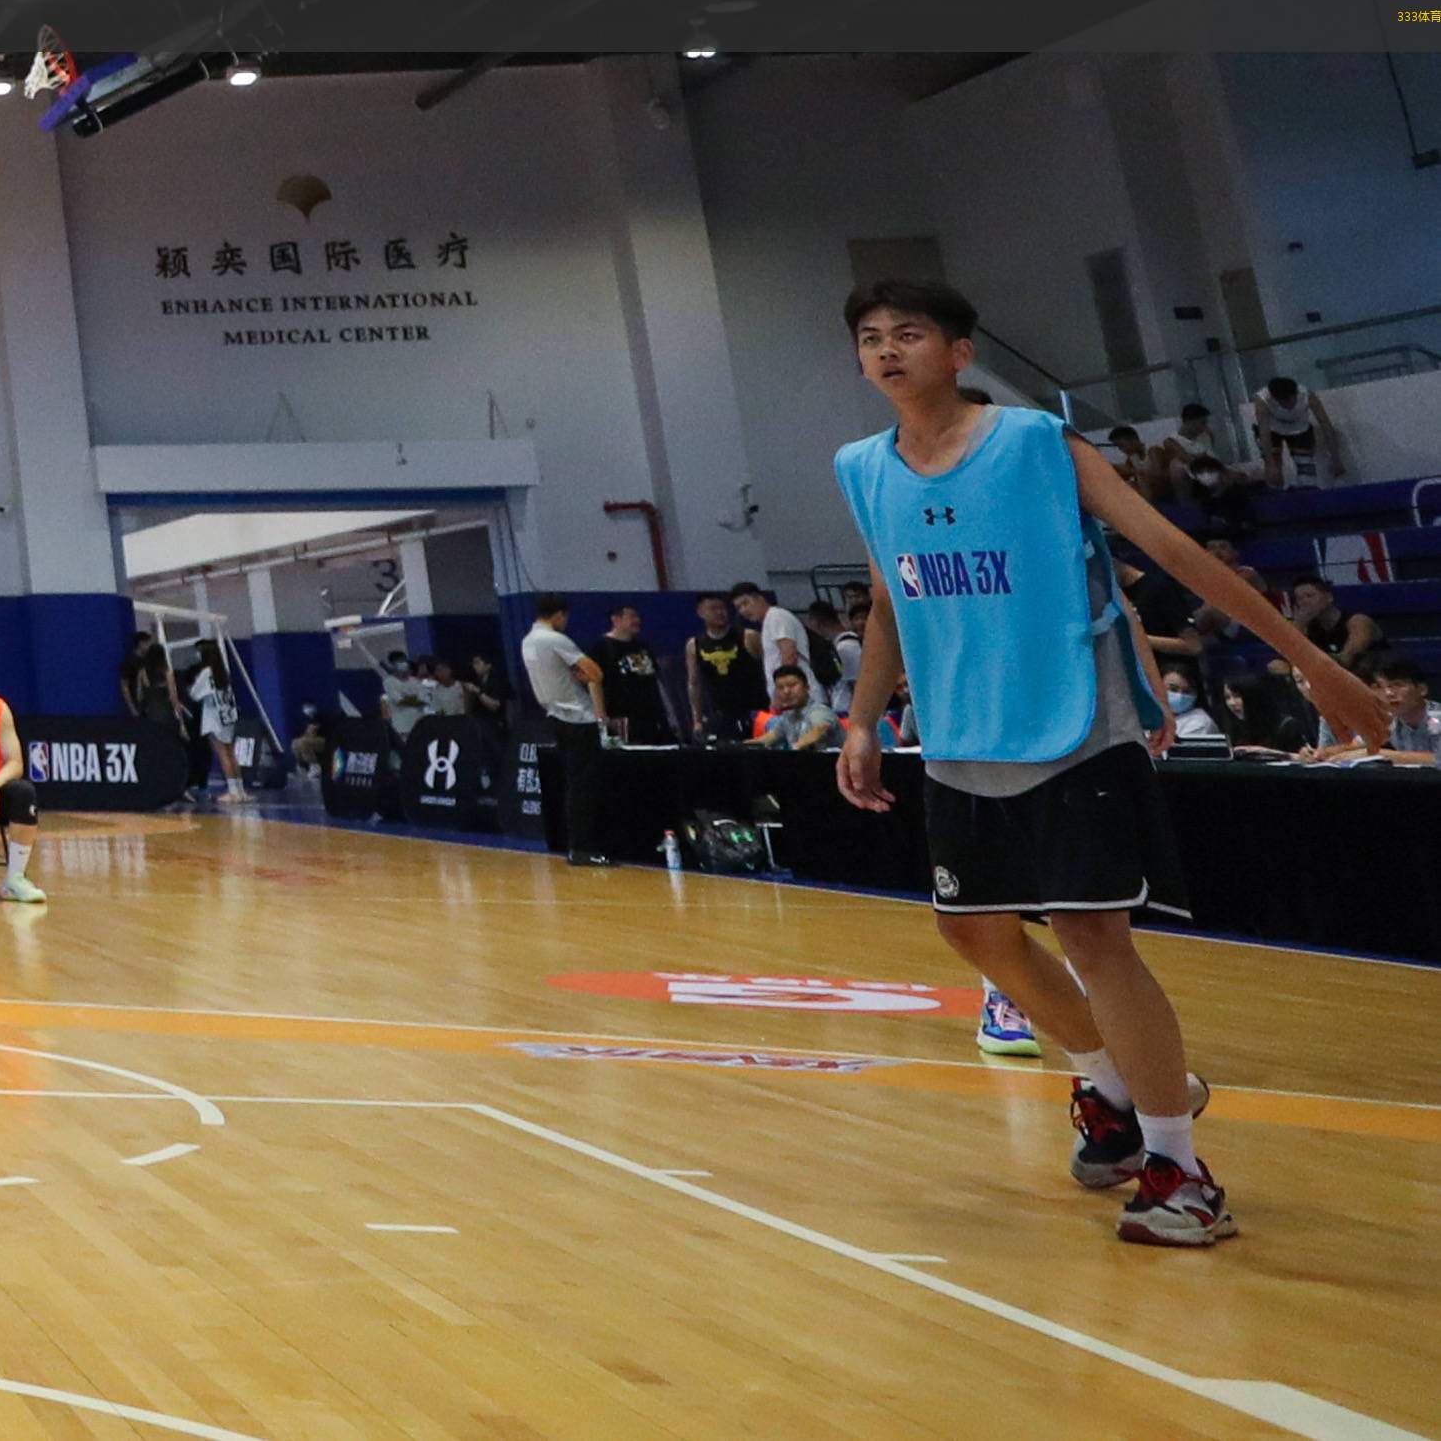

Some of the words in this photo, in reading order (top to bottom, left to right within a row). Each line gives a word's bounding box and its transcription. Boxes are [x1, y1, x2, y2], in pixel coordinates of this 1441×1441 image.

[155, 231, 470, 279] 颖奕国际医疗
[161, 297, 274, 315] ENHANCE
[280, 290, 479, 312] INTERNATIONAL
[223, 328, 332, 346] MEDICAL
[339, 325, 431, 343] CENTER
[917, 550, 974, 597] NBA
[971, 550, 1012, 595] 3X
[51, 742, 102, 782] NBA
[104, 743, 138, 783] 3X
